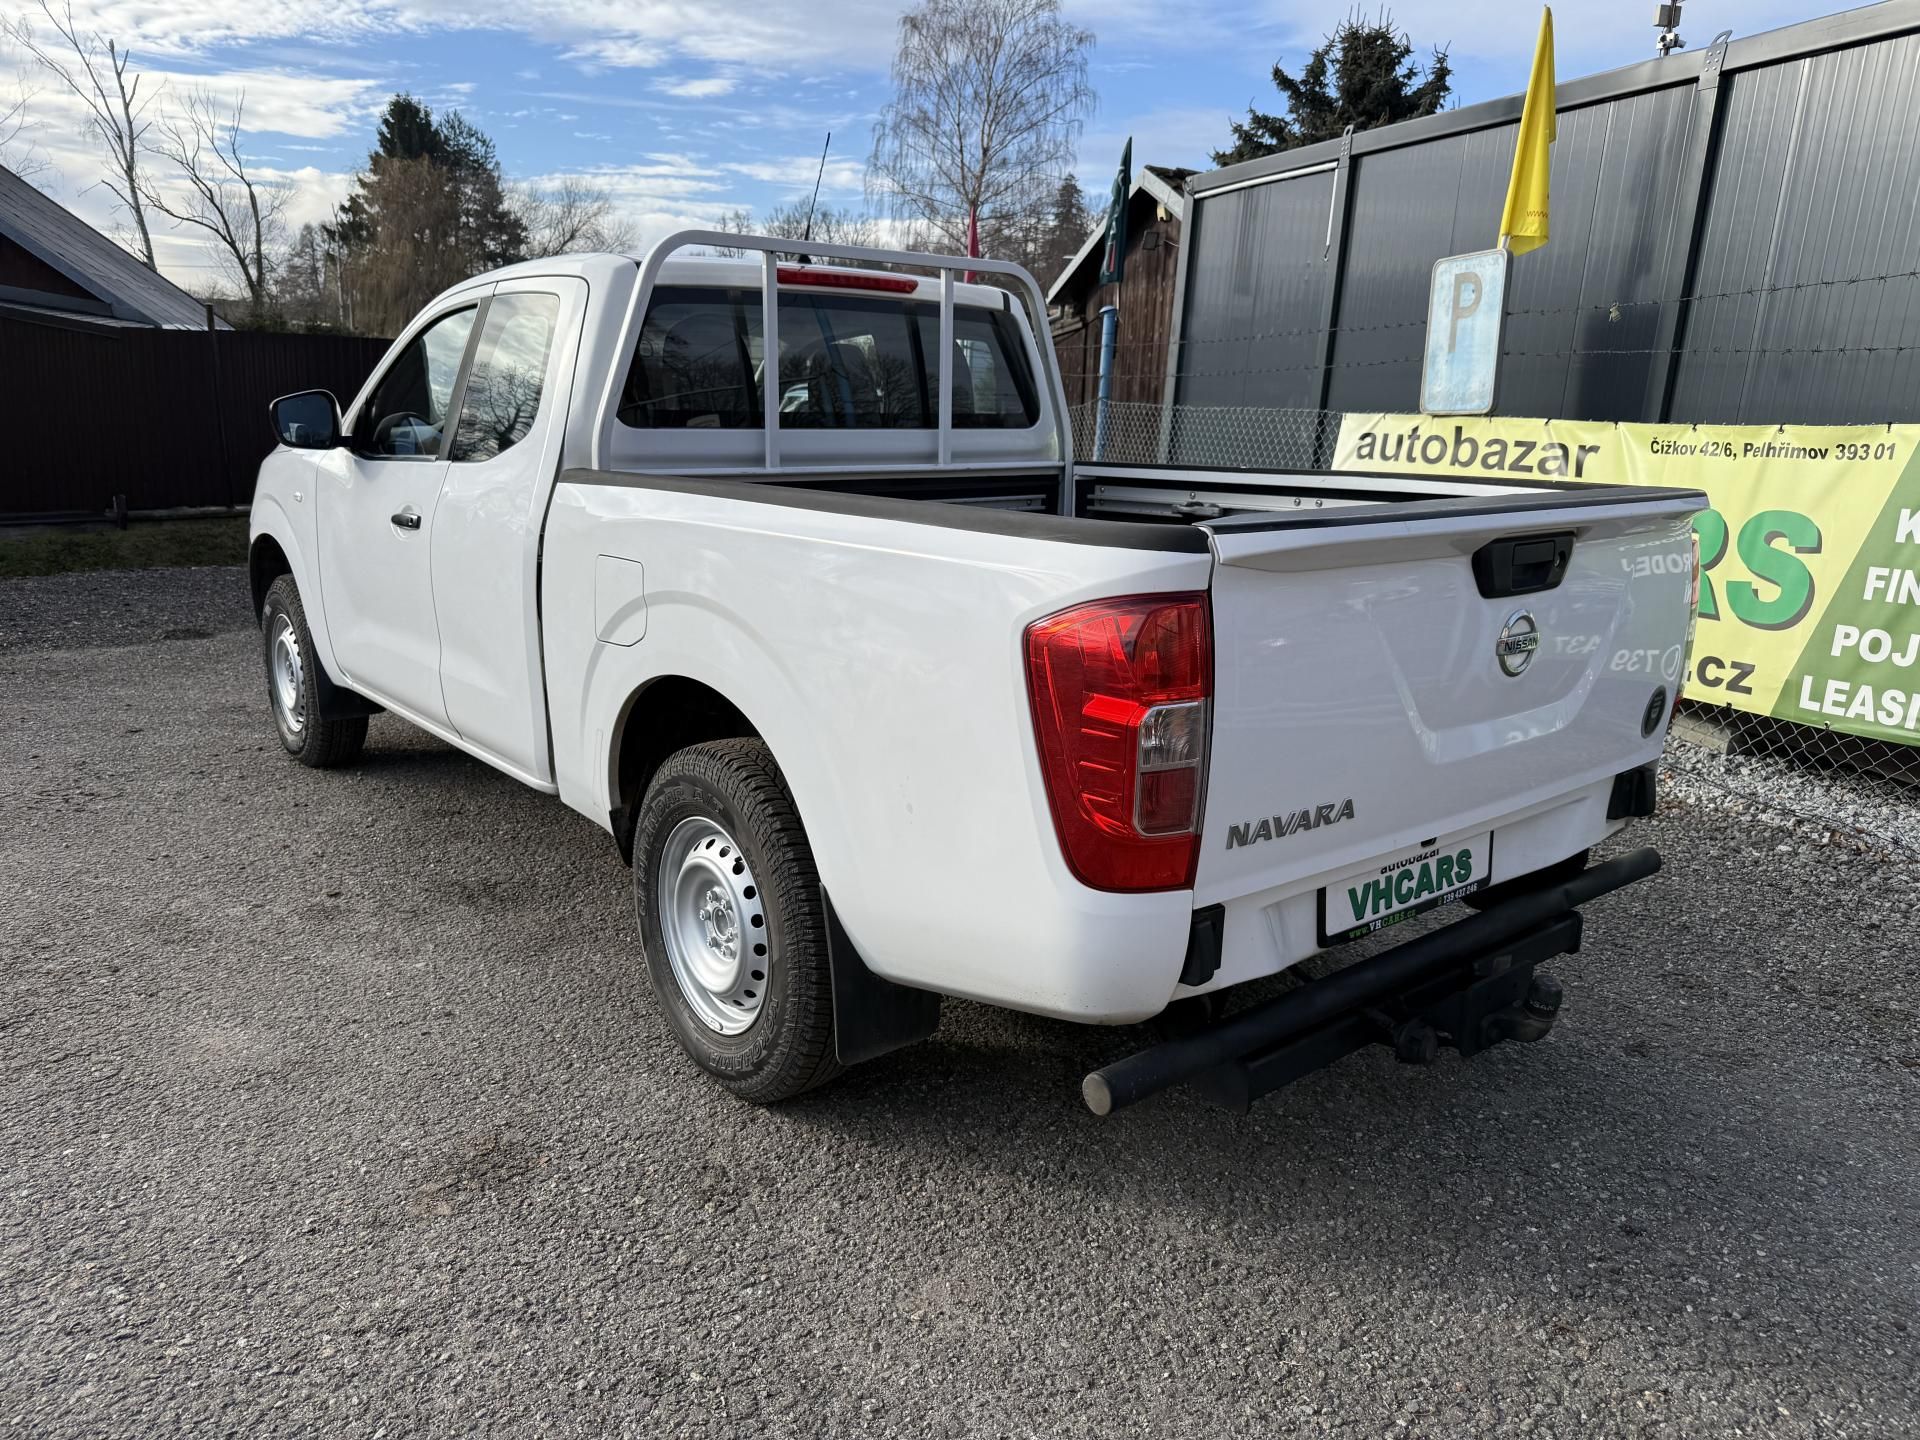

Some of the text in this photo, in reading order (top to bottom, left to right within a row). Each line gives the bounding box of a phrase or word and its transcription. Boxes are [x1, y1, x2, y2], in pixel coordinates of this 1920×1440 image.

[1448, 271, 1483, 353] P
[1355, 425, 1601, 478] autobazar
[1650, 436, 1896, 461] Čížkov 42/6, Pelhřimov 393 01
[1863, 566, 1920, 606] FIN
[1503, 636, 1538, 652] NISSAN
[1830, 624, 1920, 667] POJ
[1799, 675, 1920, 730] LEASI
[1225, 797, 1356, 849] NAVARA
[1347, 848, 1473, 922] VHCARS
